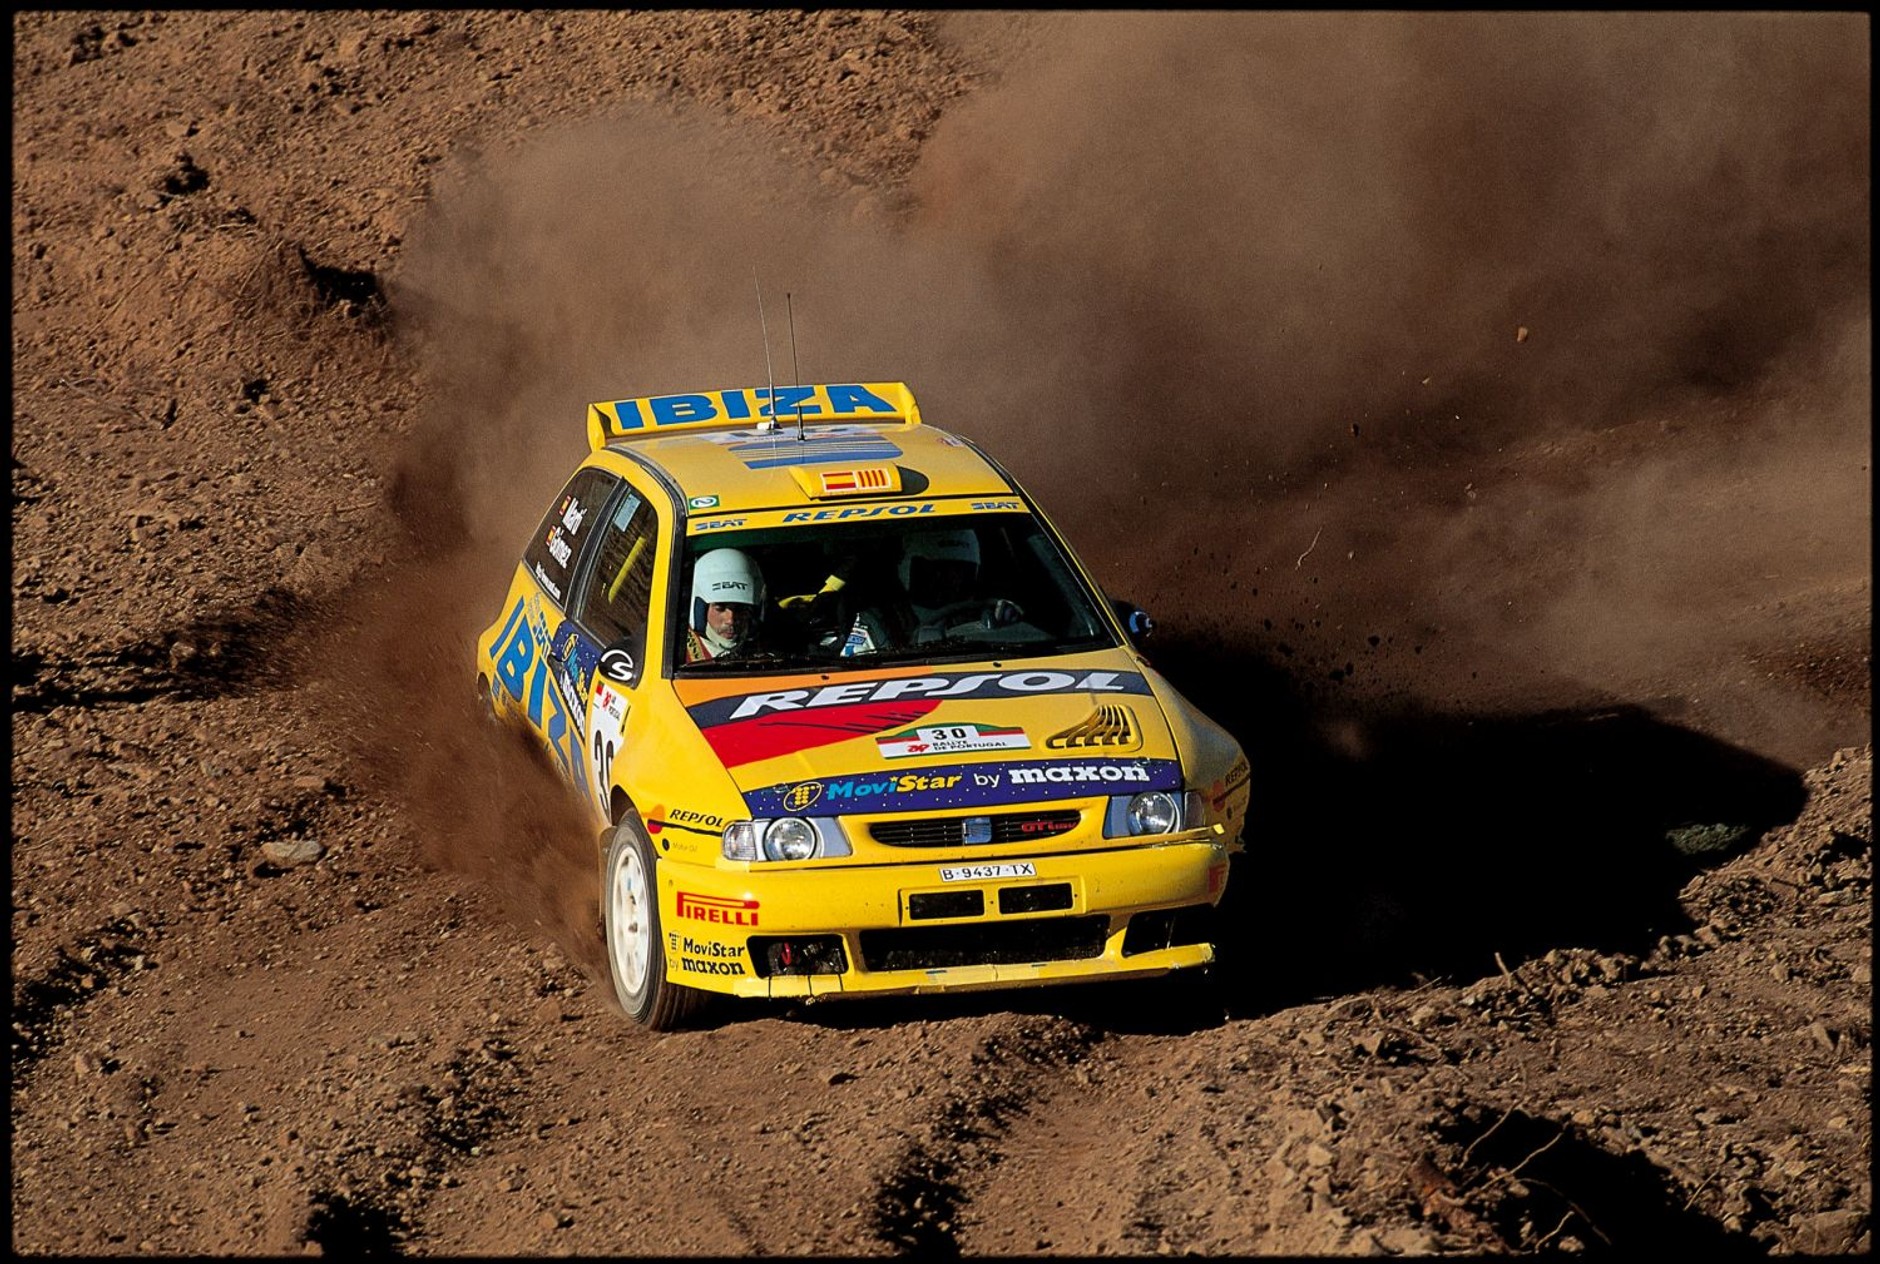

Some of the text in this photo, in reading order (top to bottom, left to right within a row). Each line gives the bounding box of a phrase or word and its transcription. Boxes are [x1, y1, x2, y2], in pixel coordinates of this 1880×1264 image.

[614, 384, 897, 429] IBIZA
[695, 502, 1020, 531] SEAT REPSOL SEAT
[712, 581, 748, 591] SEAT
[729, 672, 1125, 720] REPSOL
[931, 727, 967, 740] 30
[950, 741, 1008, 750] PORTUGAL
[827, 774, 962, 801] MoviStar
[973, 772, 1001, 789] by
[1008, 764, 1150, 784] maxon
[669, 808, 723, 828] REPSOL
[677, 891, 760, 926] PIRELLI
[683, 937, 745, 958] MoviStar
[681, 957, 746, 976] maxon
